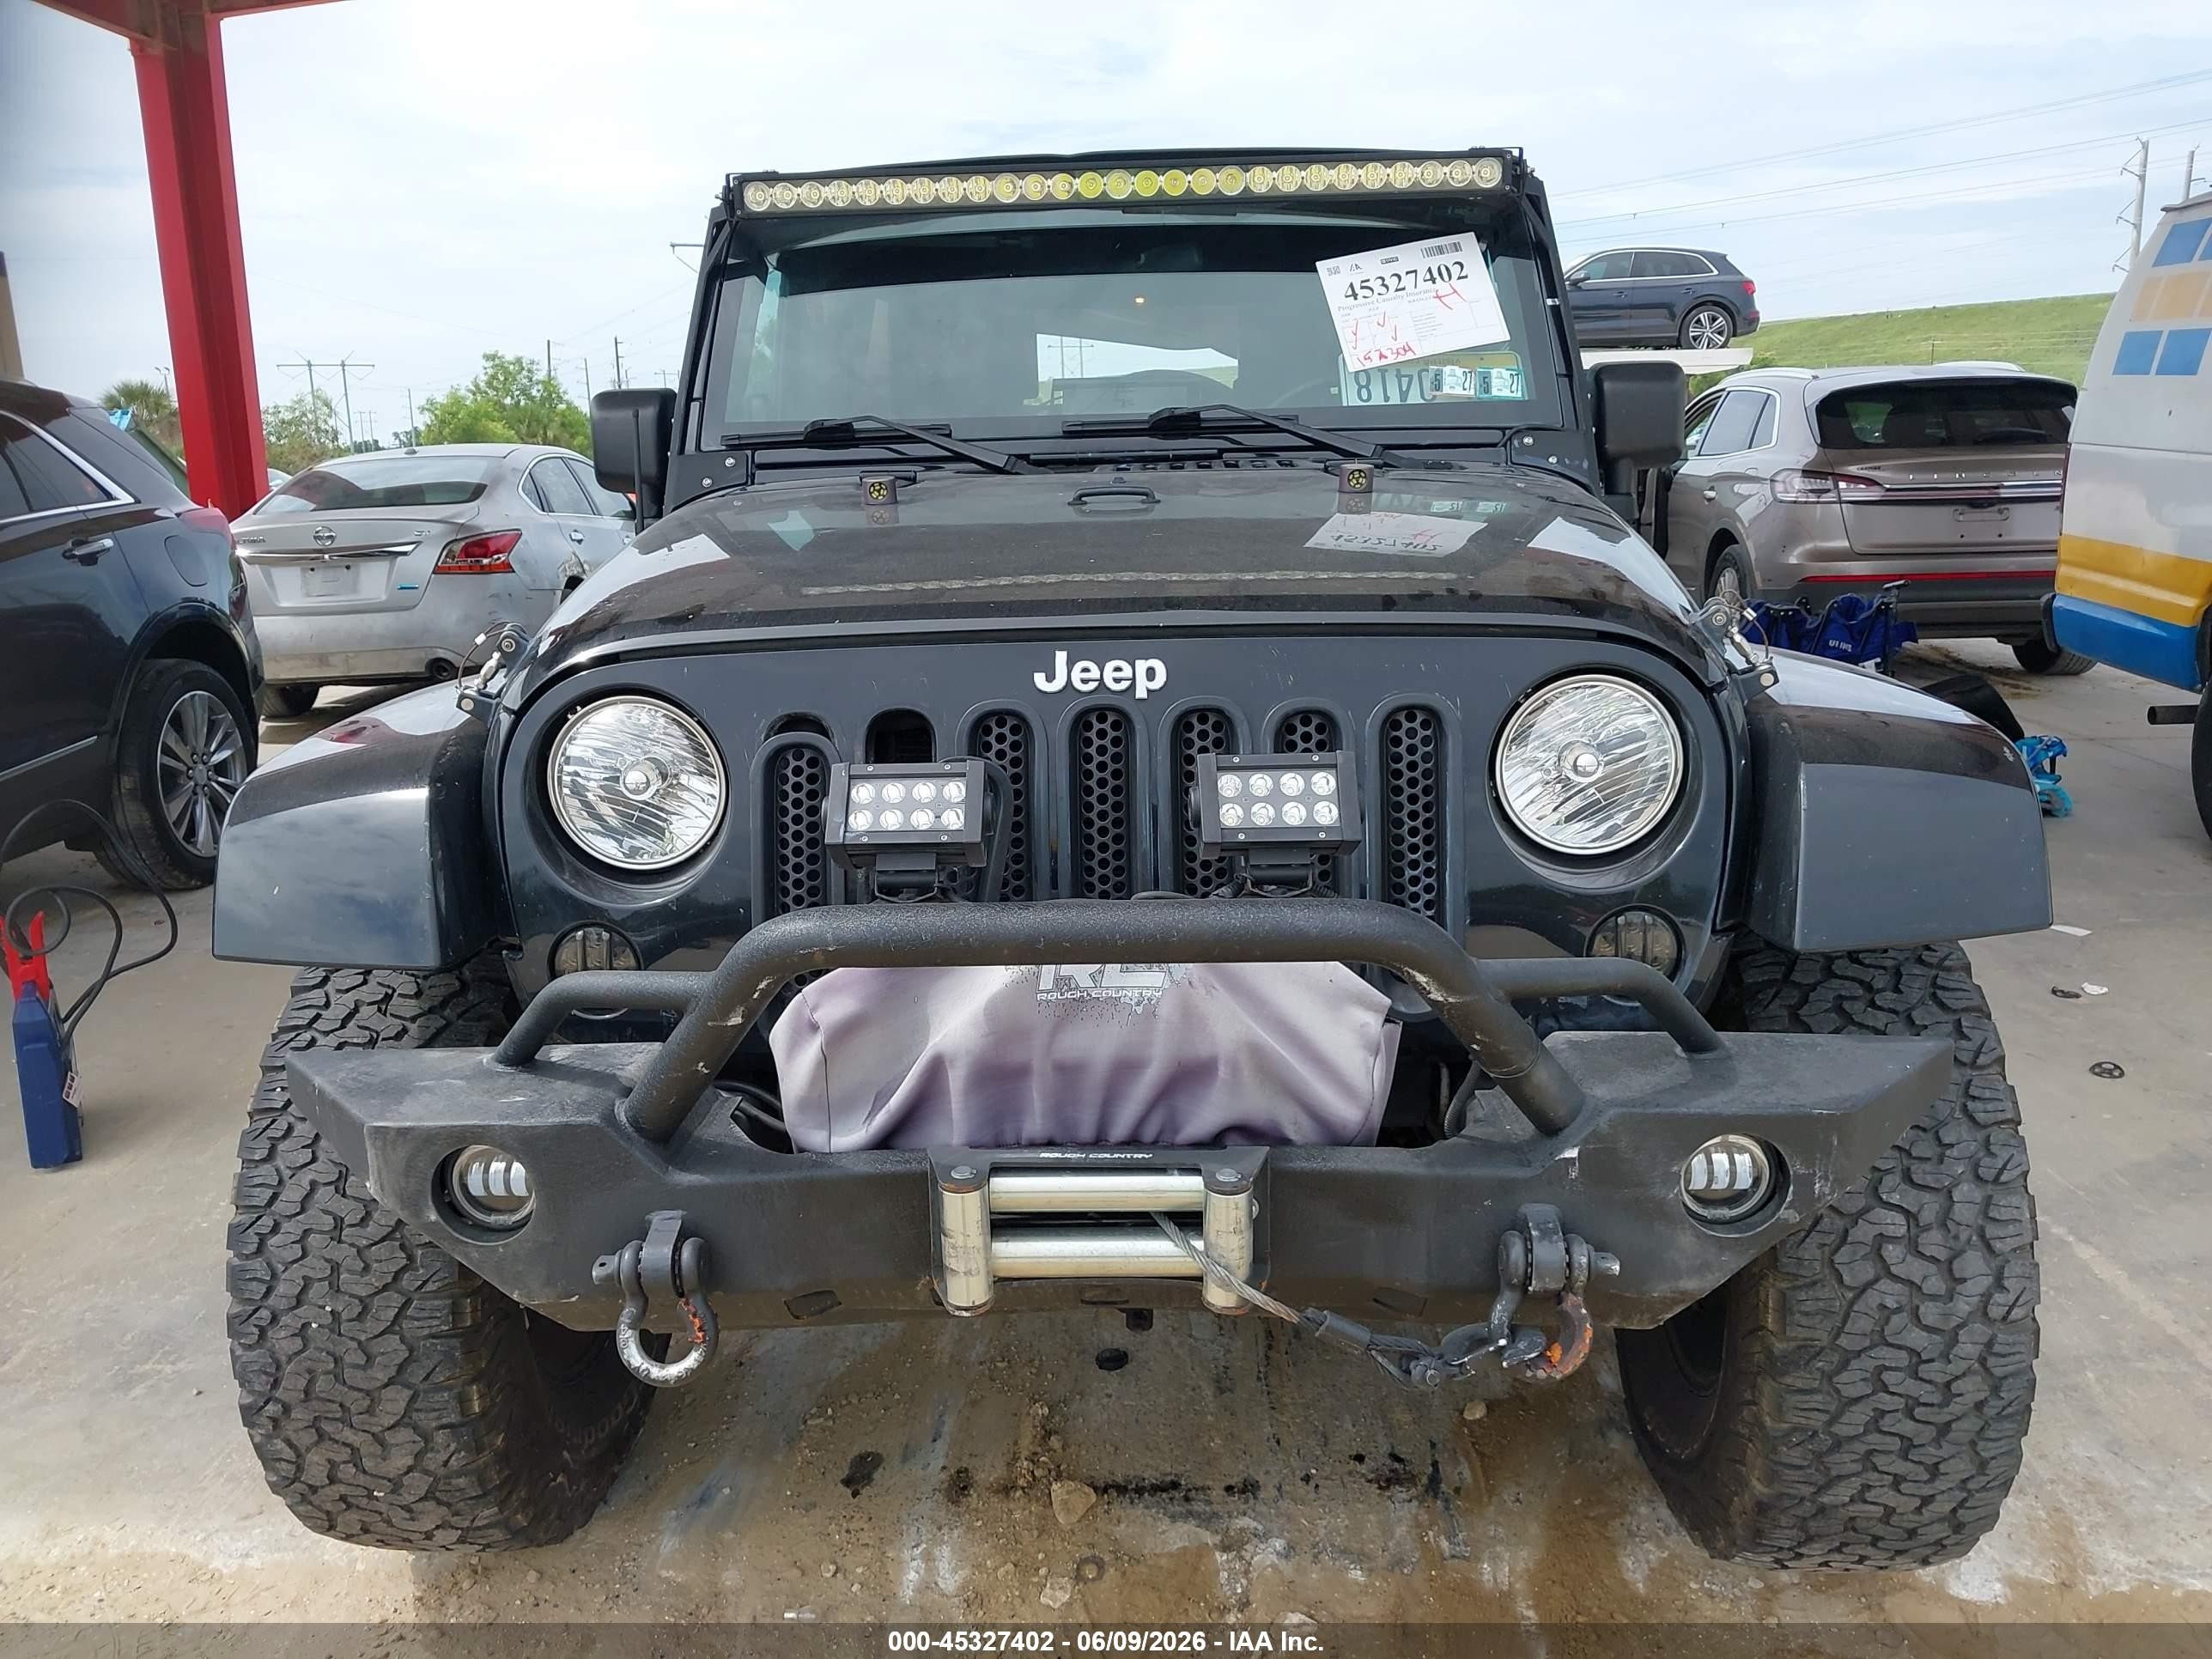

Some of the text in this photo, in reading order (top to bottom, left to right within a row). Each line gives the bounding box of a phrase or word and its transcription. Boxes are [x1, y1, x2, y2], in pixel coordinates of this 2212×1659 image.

[1344, 260, 1469, 301] 45327402
[1338, 298, 1376, 312] Progressive
[1376, 293, 1405, 305] Casualty
[1462, 370, 1473, 392] 27
[1509, 372, 1520, 392] 27
[1033, 650, 1167, 700] Jeep
[1036, 988, 1163, 1001] ROUGH COUNTRY
